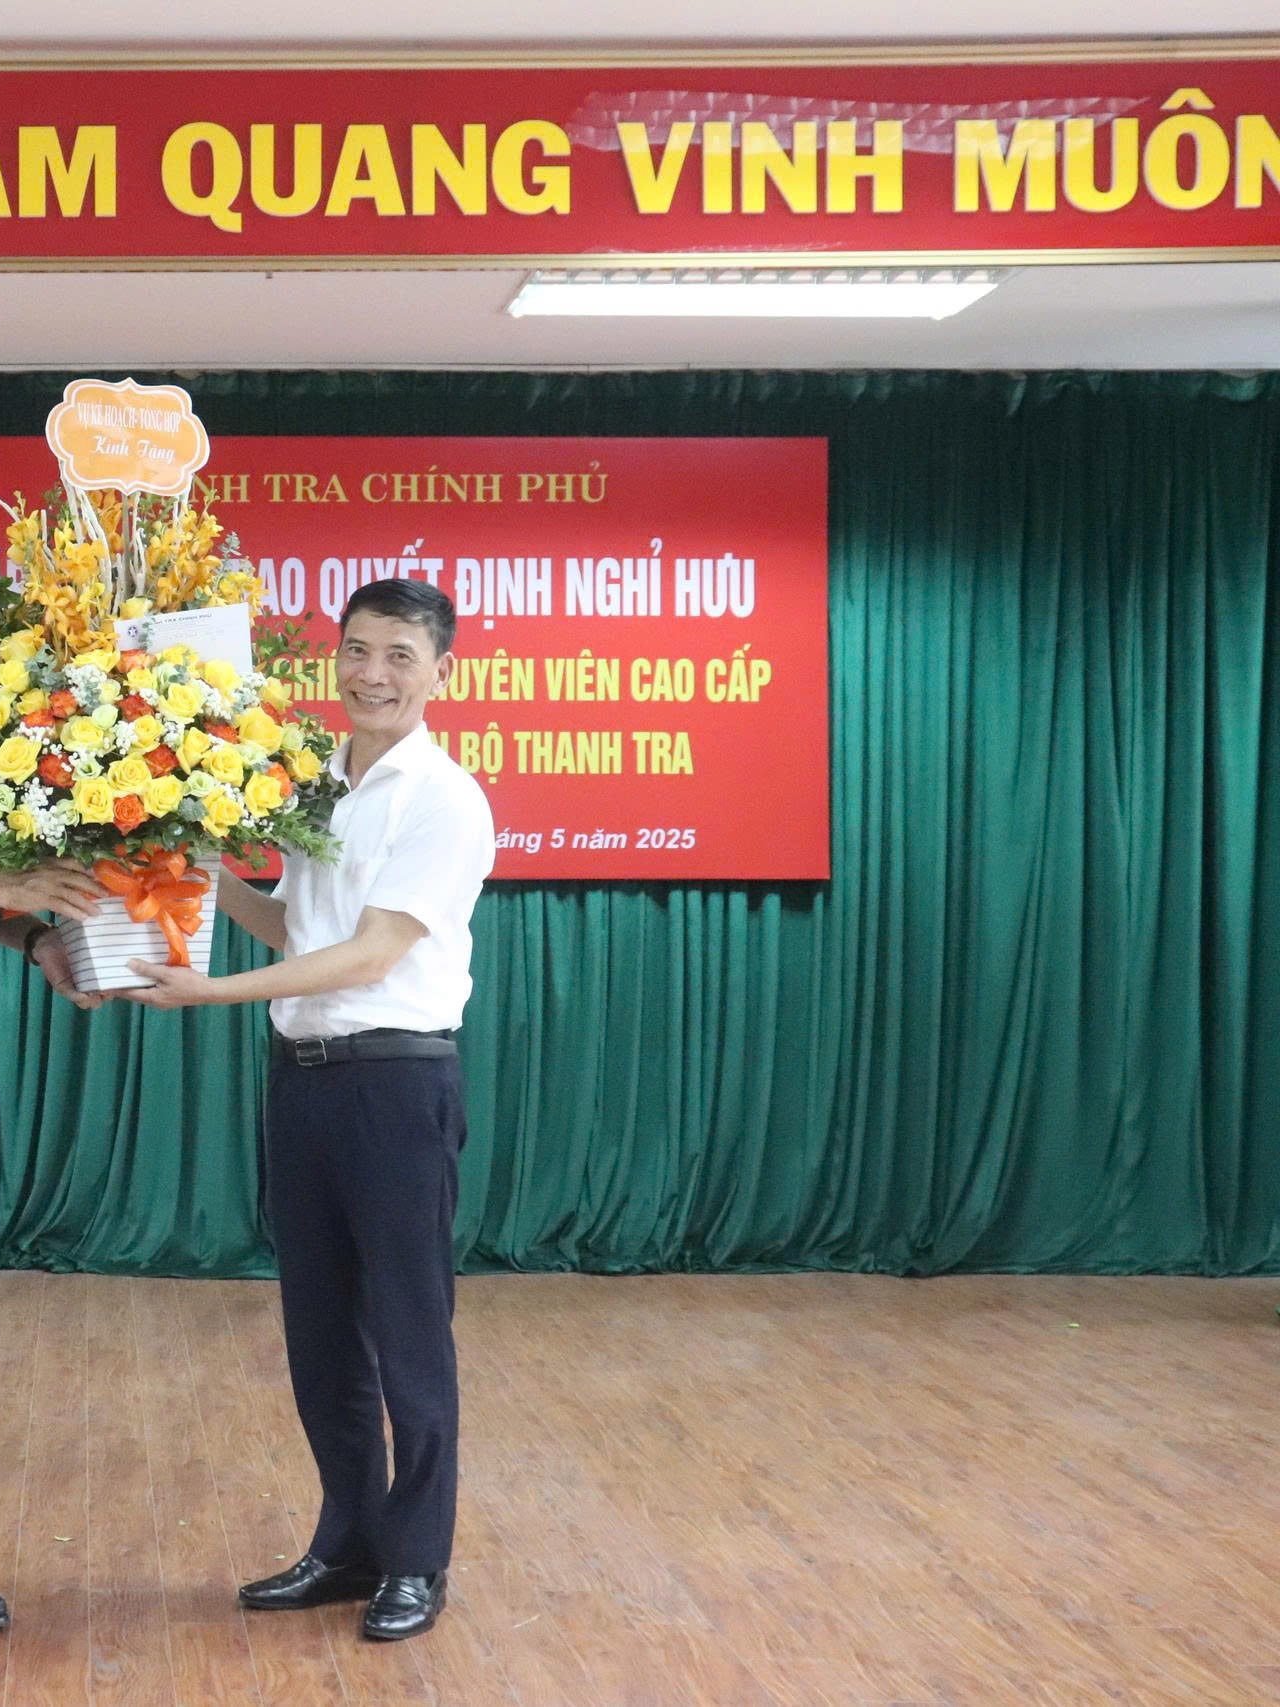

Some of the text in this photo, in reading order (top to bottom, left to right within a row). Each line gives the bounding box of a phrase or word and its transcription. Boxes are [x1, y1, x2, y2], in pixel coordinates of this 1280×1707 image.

[162, 120, 571, 233] QUANG
[617, 119, 902, 214] VINH
[263, 474, 348, 503] TRA
[362, 465, 502, 503] CHÍNH
[518, 461, 608, 503] PHỦ
[454, 557, 553, 630] ĐỊNH
[565, 537, 662, 617] NGHỈ
[675, 552, 755, 618] HƯU
[544, 648, 620, 702] VIÊN
[630, 658, 695, 702] CAO
[705, 643, 772, 702] CẤP
[460, 722, 503, 785] BỘ
[513, 731, 622, 775] THANH
[632, 731, 694, 775] TRA
[550, 829, 565, 849] 5
[572, 828, 627, 850] năm
[636, 829, 696, 850] 2025
